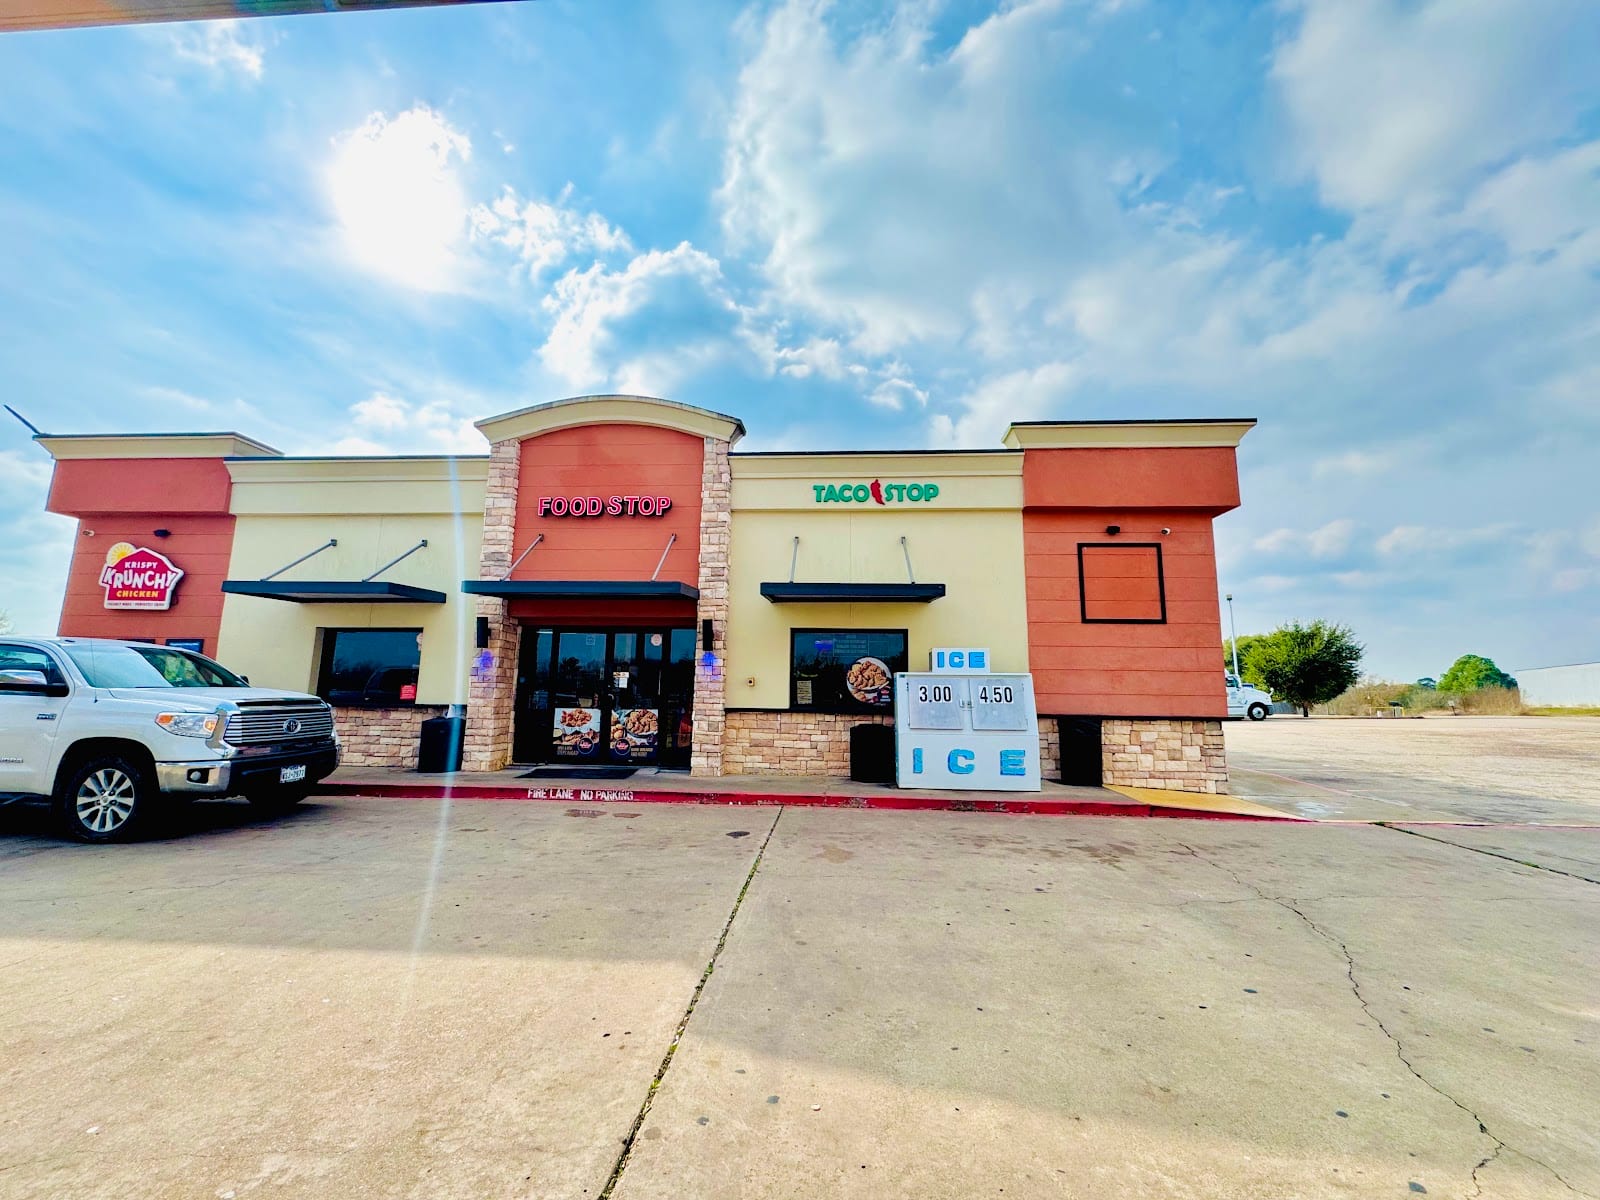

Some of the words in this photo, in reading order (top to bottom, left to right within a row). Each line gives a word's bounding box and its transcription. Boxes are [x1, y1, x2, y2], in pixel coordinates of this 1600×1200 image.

[812, 484, 870, 503] TACO
[884, 483, 939, 502] STOP
[537, 496, 602, 516] FOOD
[606, 495, 671, 516] STOP
[124, 561, 158, 569] KRISPY
[102, 567, 177, 590] KRUNCHY
[116, 590, 159, 598] CHICKEN
[936, 651, 986, 669] ICE
[919, 686, 952, 703] 3.00
[980, 686, 1013, 703] 4.50
[912, 747, 1026, 776] ICE
[527, 788, 548, 799] FIRE
[549, 788, 575, 800] LANE
[580, 789, 594, 801] NO
[595, 790, 634, 801] PARKING
